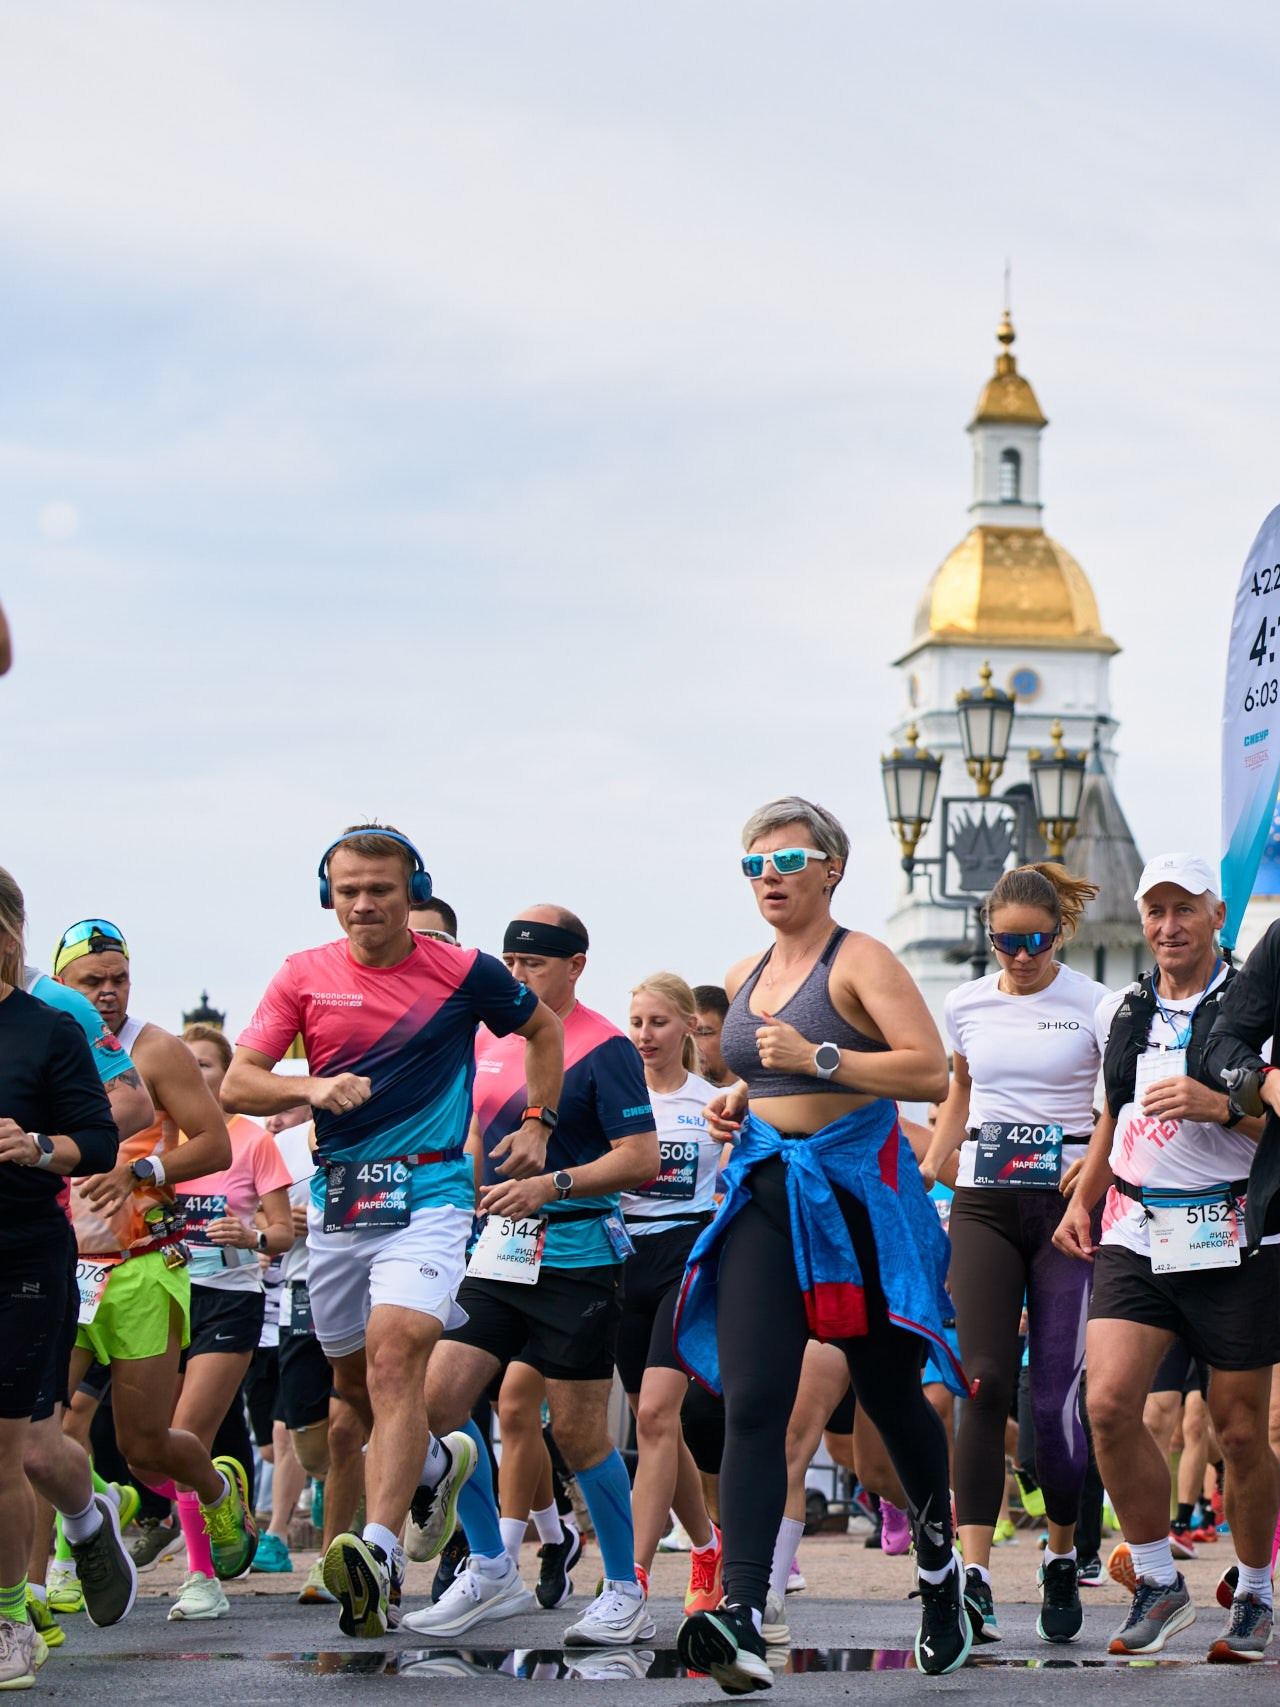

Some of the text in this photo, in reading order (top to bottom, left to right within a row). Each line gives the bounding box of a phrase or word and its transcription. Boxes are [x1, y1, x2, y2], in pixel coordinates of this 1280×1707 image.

[1244, 678, 1278, 712] 6:03
[1244, 728, 1269, 747] СИБУР
[311, 992, 363, 1000] ТОБОЛЬСКИЙ
[1037, 1021, 1079, 1031] ЭНКО
[1006, 1125, 1058, 1145] 4204
[660, 1144, 695, 1161] 508
[1033, 1153, 1057, 1162] #ИДУ
[356, 1163, 406, 1183] 4516
[1012, 1160, 1057, 1171] НАРЕКОРД
[185, 1195, 224, 1212] 4142
[379, 1191, 407, 1201] #ИДУ
[358, 1200, 407, 1209] НАРЕКОРД
[1186, 1204, 1232, 1224] 5152
[500, 1219, 541, 1240] 5144
[1209, 1231, 1234, 1239] #ИДУ
[1189, 1239, 1234, 1250] НАРЕКОРД
[496, 1253, 536, 1266] НАРЕКОРД
[76, 1263, 106, 1282] 076
